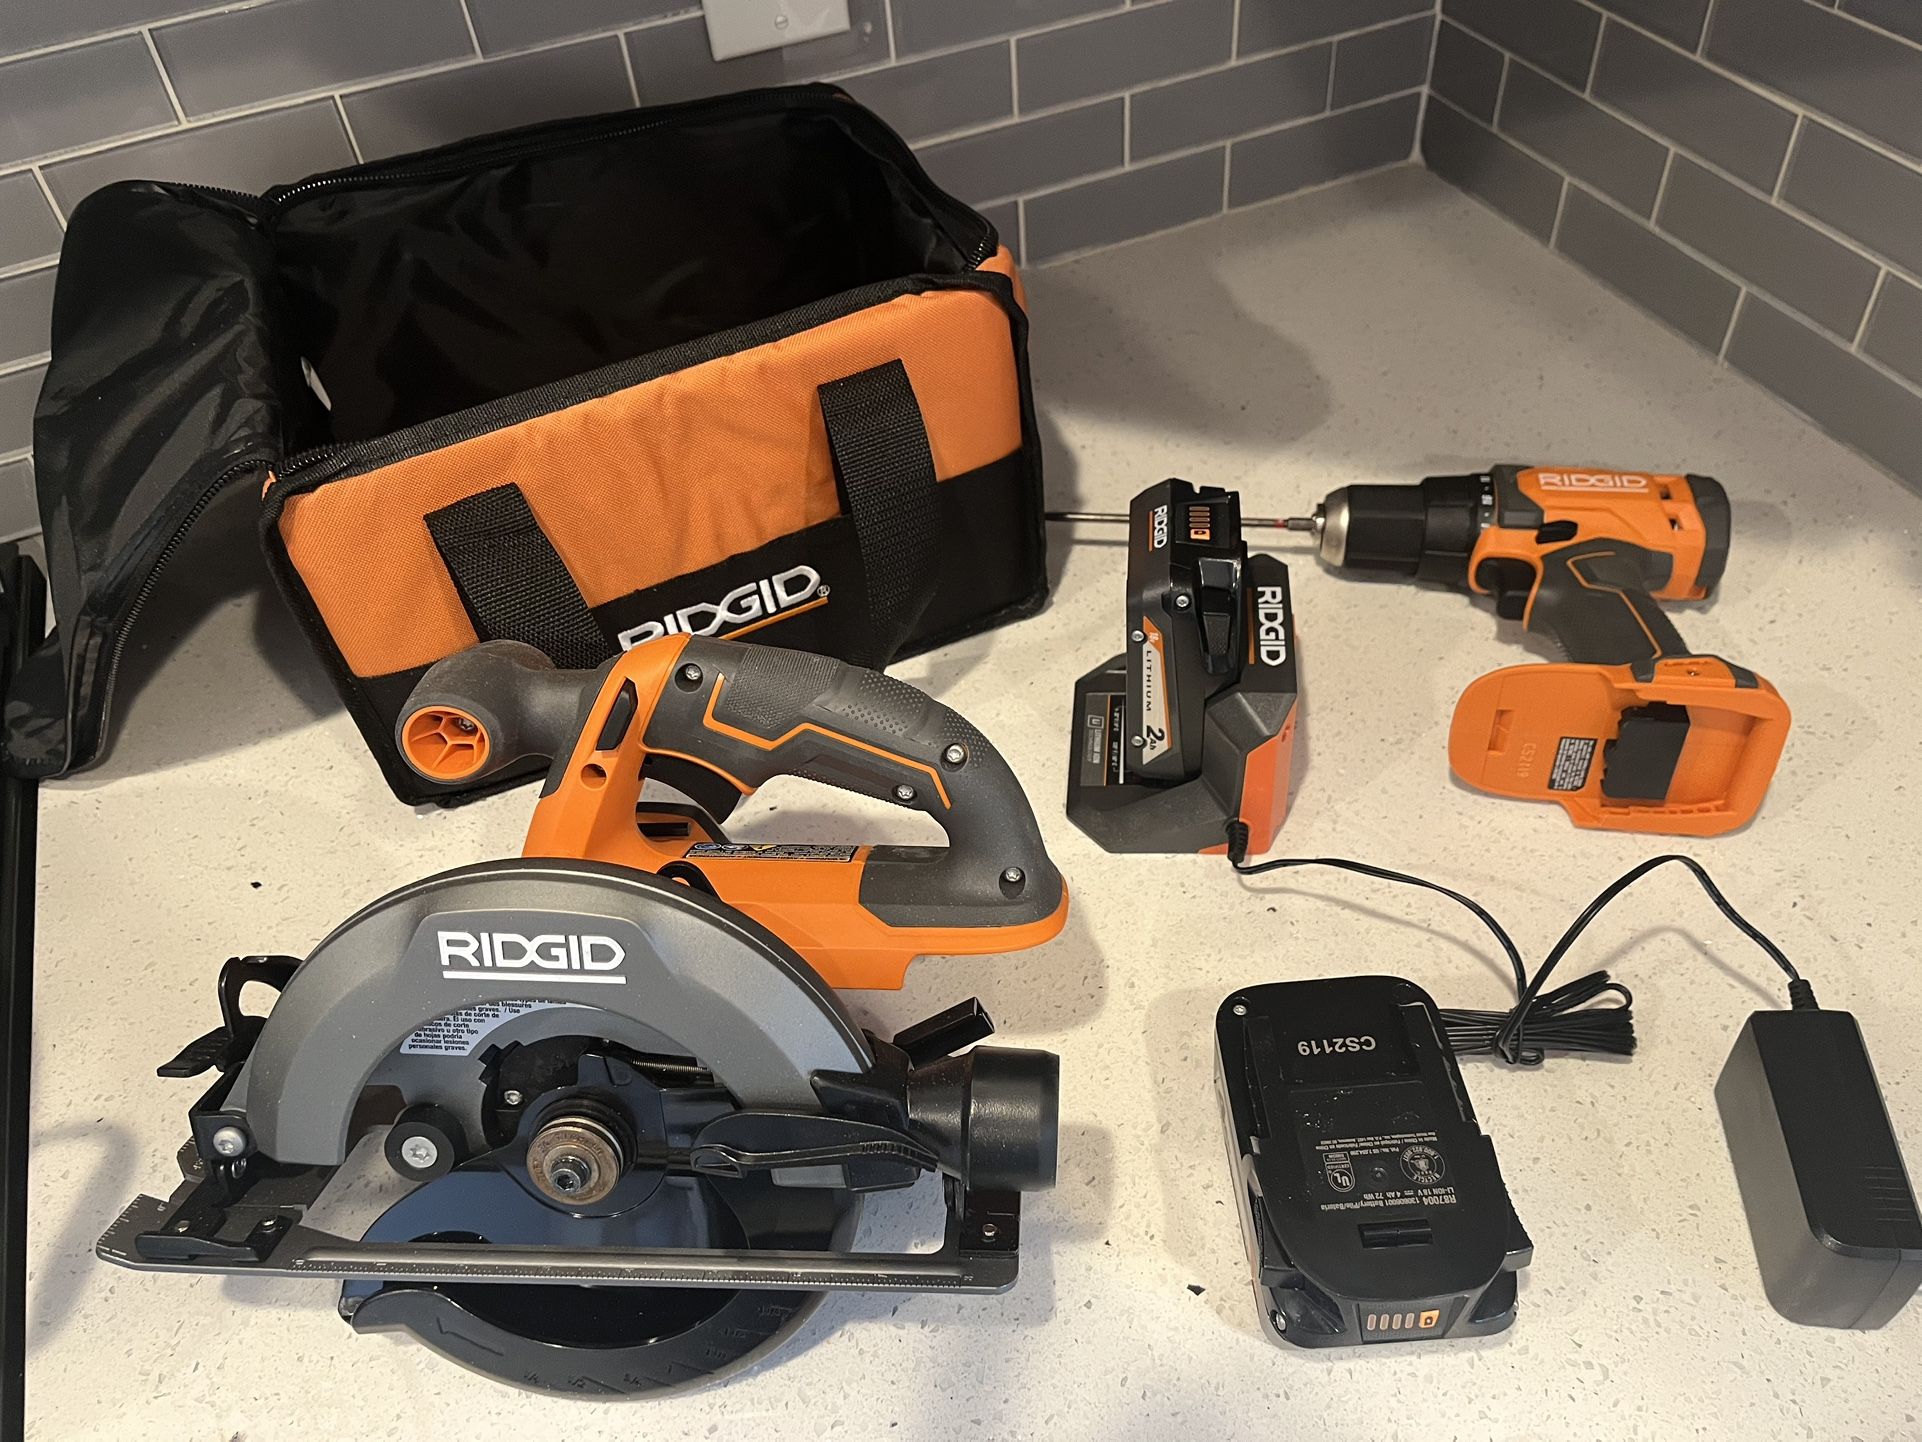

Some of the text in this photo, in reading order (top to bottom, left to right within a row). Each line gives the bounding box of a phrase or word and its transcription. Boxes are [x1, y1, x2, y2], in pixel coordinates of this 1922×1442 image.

[1538, 472, 1648, 488] RIDGID
[1153, 504, 1168, 549] RIDGID
[617, 564, 822, 652] RIDGID
[1257, 586, 1287, 666] RIDGID
[437, 930, 626, 972] RIDGID
[1296, 1036, 1376, 1056] CS2119
[1333, 1172, 1350, 1187] UL
